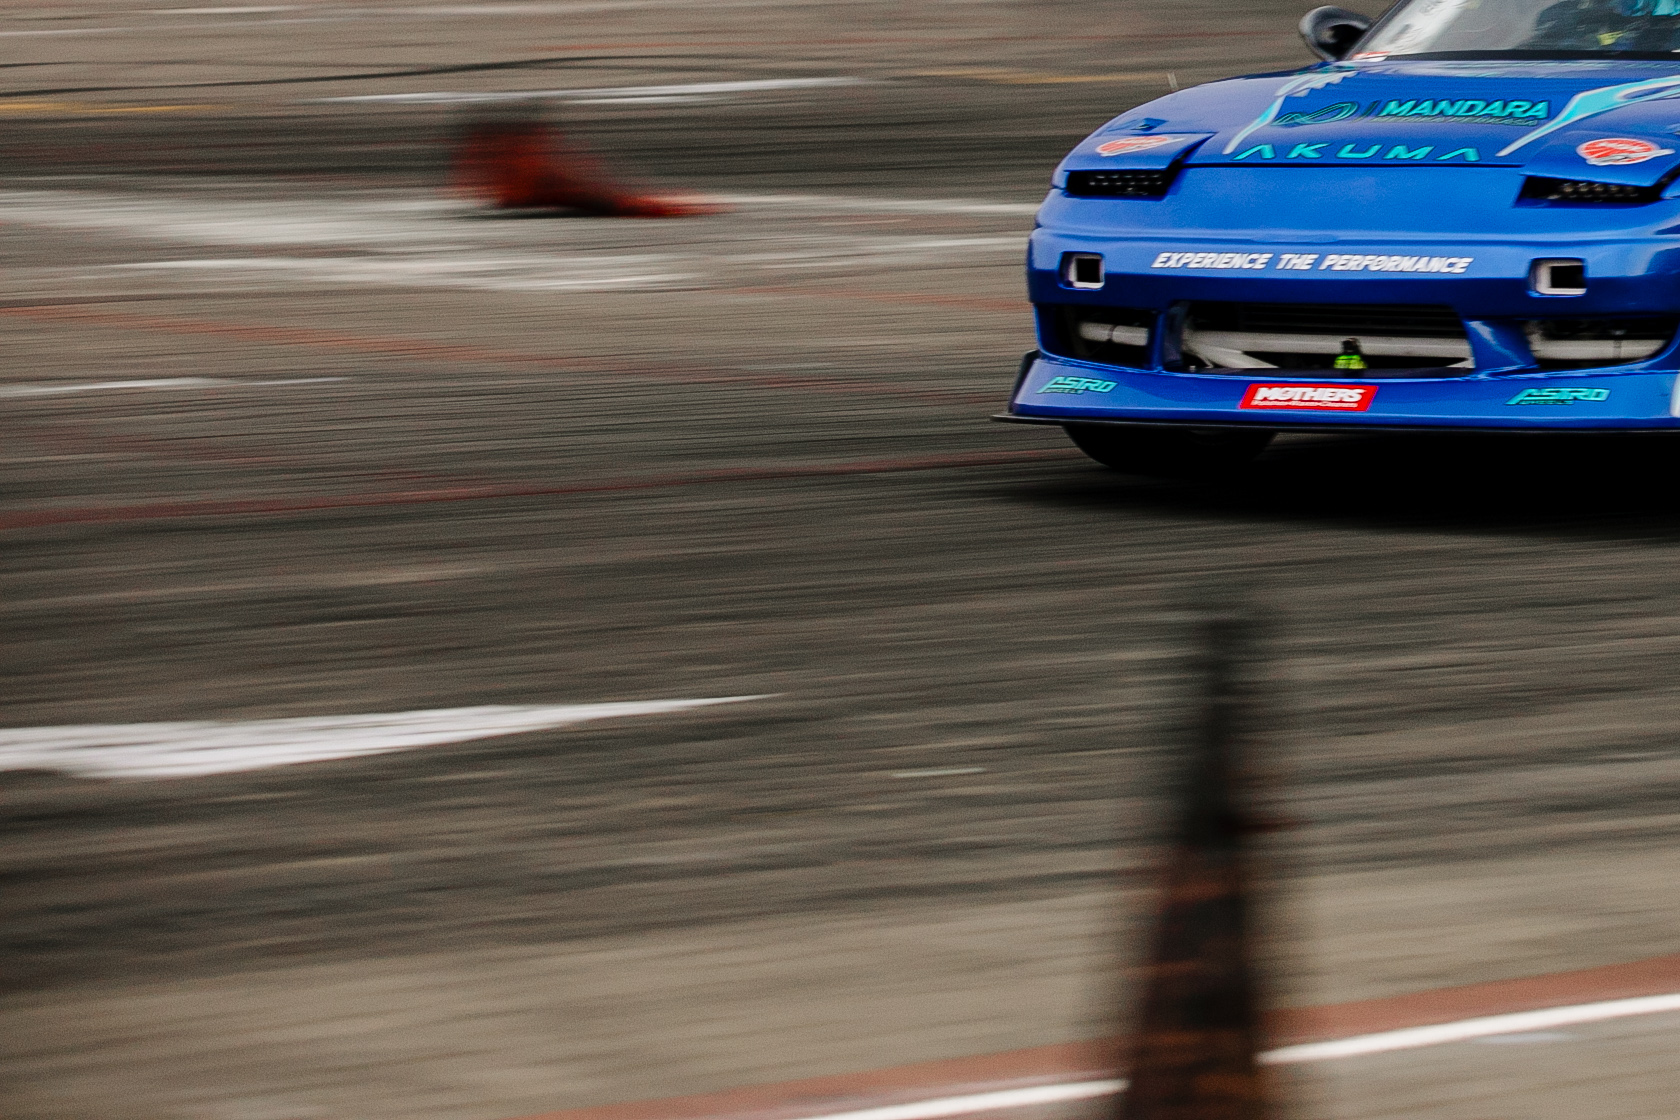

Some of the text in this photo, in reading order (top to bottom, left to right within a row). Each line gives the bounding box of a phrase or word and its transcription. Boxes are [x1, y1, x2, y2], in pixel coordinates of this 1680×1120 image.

[1377, 99, 1549, 119] MANDARA
[1231, 142, 1481, 162] AKUMA
[1151, 252, 1474, 275] EXPERIENCE THE PERFORMANCE
[1036, 376, 1118, 394] ASTRO
[1253, 387, 1367, 403] MOTHERS
[1505, 388, 1612, 405] ASTRO
